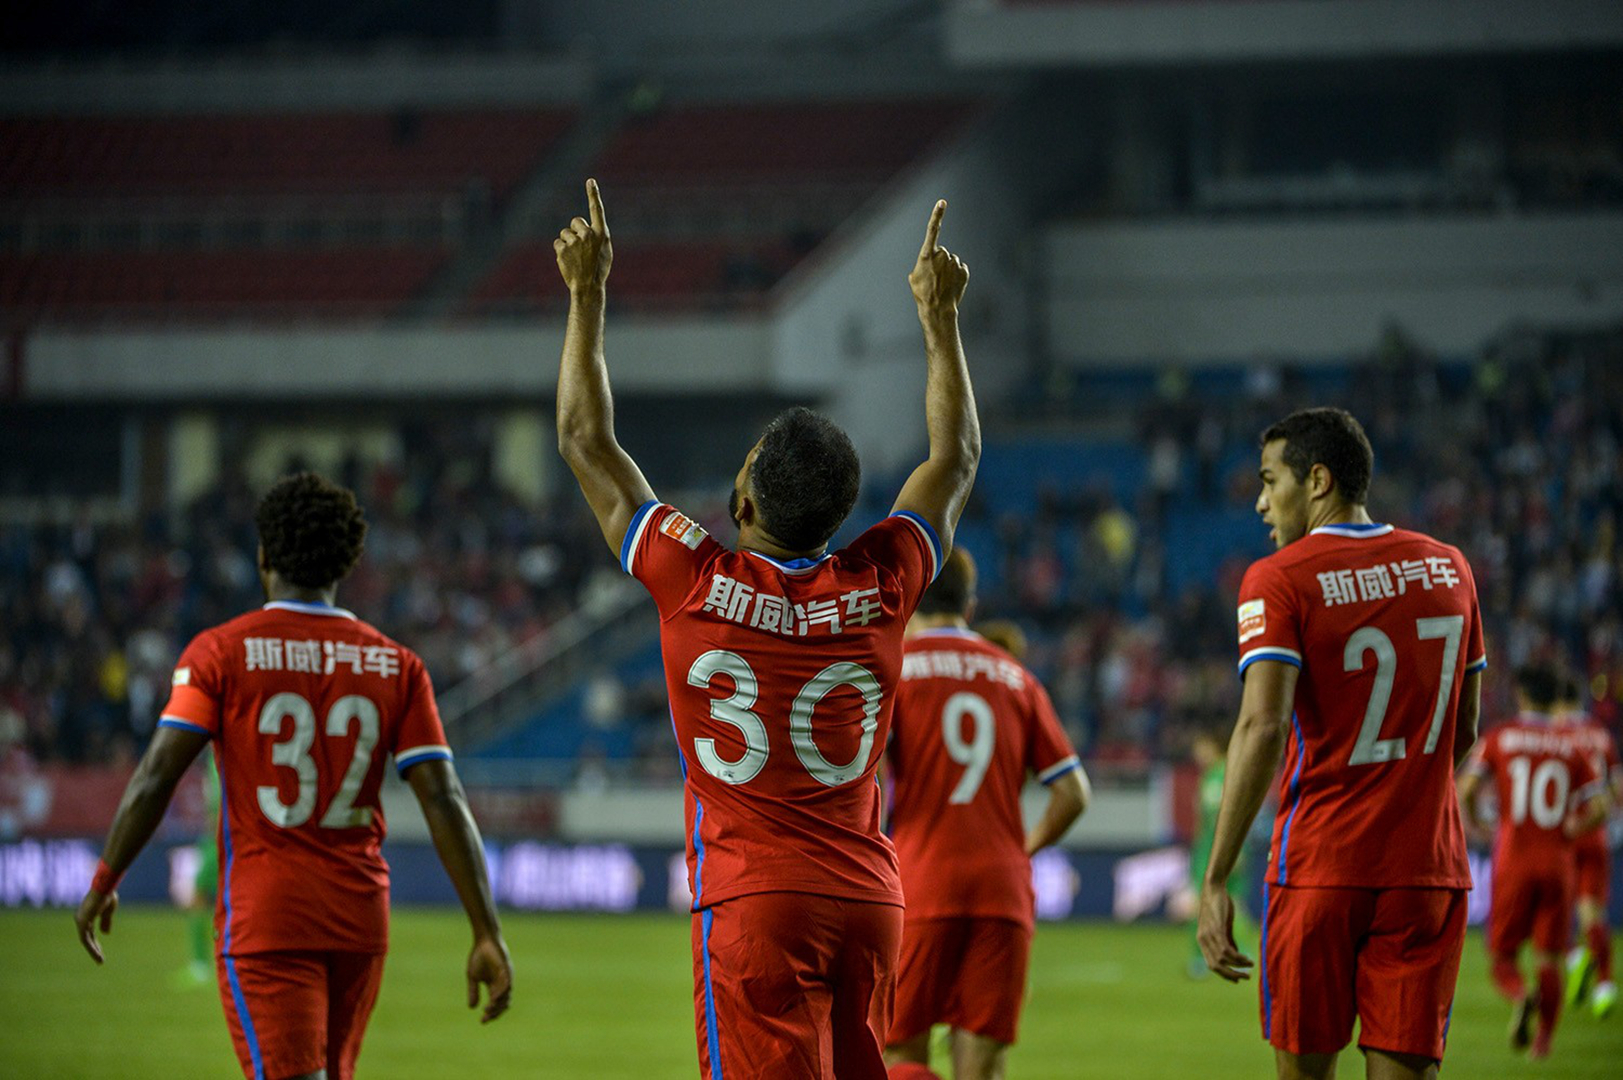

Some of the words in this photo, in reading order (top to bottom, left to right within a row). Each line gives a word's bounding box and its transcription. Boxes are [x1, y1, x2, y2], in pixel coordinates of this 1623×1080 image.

[702, 573, 881, 636] 斯威汽车
[1317, 557, 1459, 606] 斯威汽车
[244, 638, 400, 677] 斯威汽车
[1343, 614, 1464, 766] 27
[257, 692, 380, 828] 32
[687, 650, 883, 787] 30
[942, 692, 996, 805] 9
[1508, 756, 1571, 829] 10
